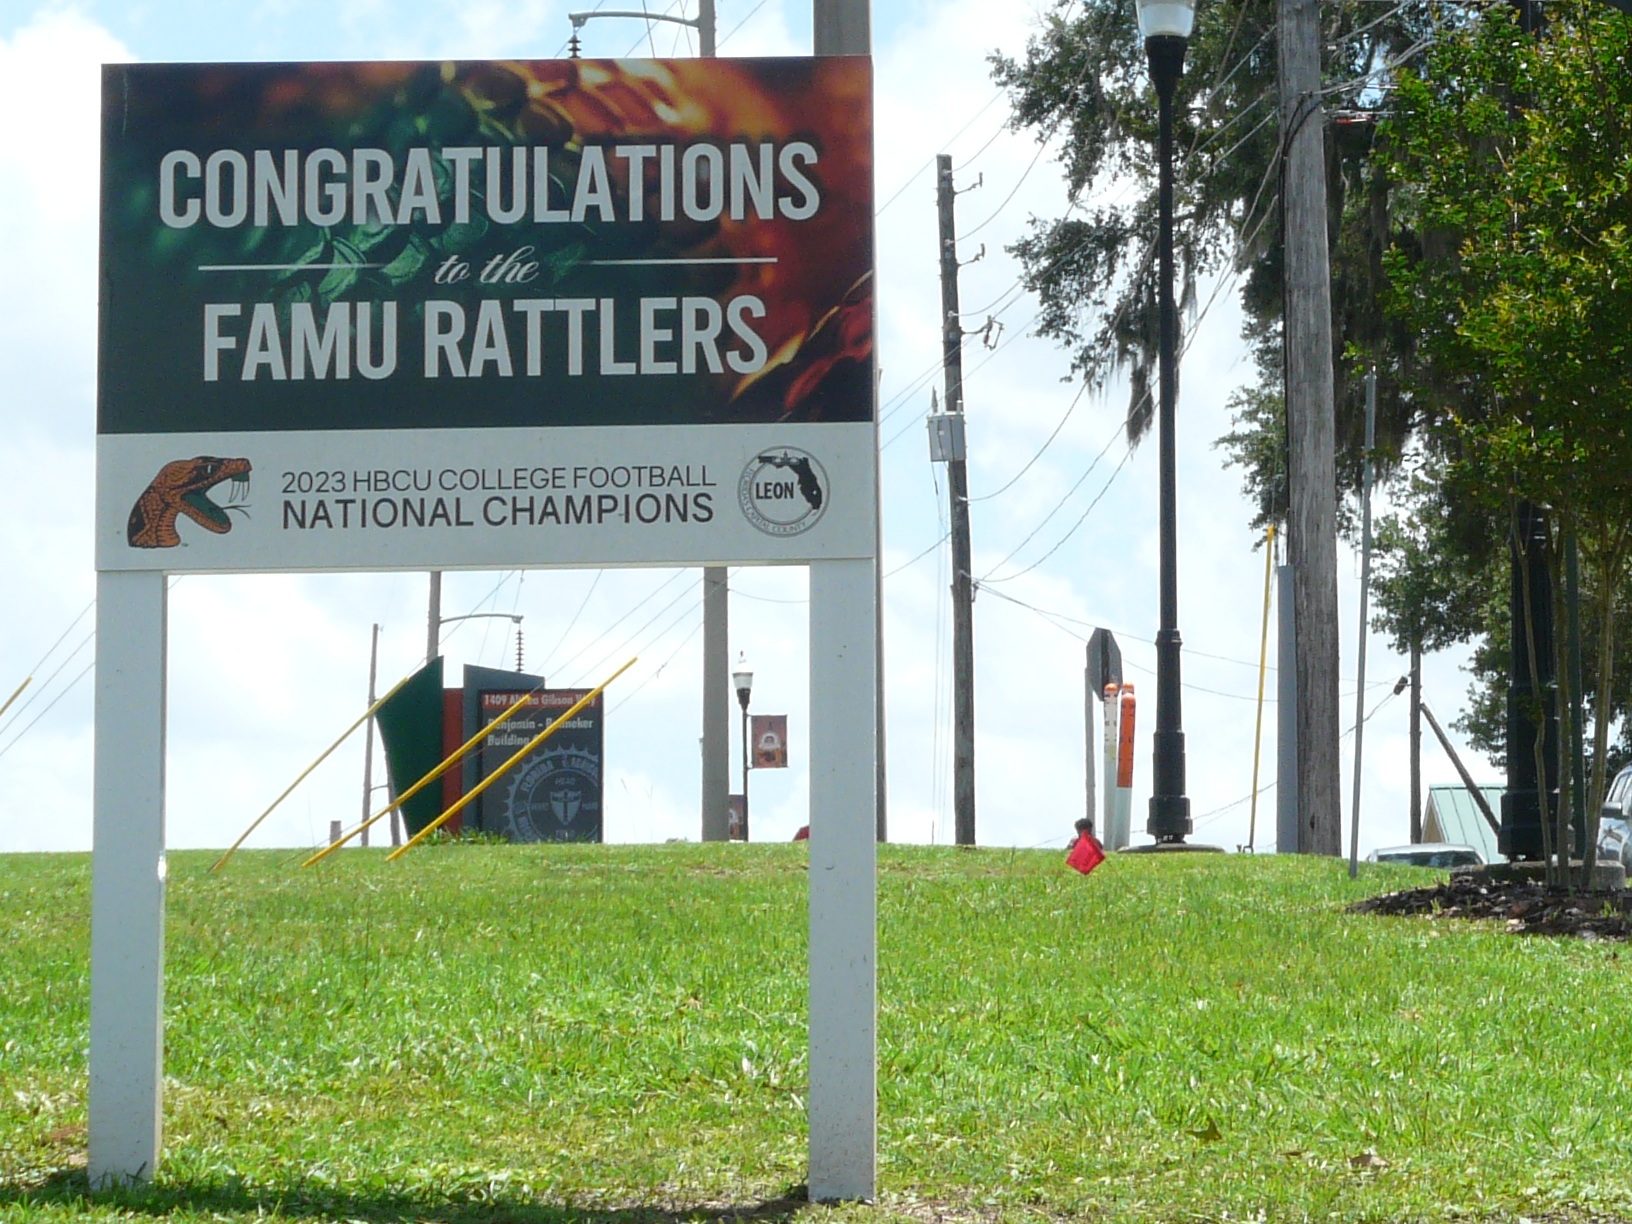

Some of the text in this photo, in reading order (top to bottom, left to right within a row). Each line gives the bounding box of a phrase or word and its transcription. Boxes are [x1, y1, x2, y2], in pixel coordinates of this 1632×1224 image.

[158, 142, 821, 230] CONGRATULATIONS
[434, 245, 540, 286] to the
[203, 294, 769, 383] FAMU RATTLERS
[281, 470, 346, 493] 2023
[354, 469, 433, 492] HBCU
[437, 466, 568, 491] COLLEGE
[571, 463, 717, 489] FOOTBALL
[755, 482, 794, 500] LEON
[281, 491, 715, 531] NATIONAL CHAMPIONS
[485, 695, 507, 705] 1409
